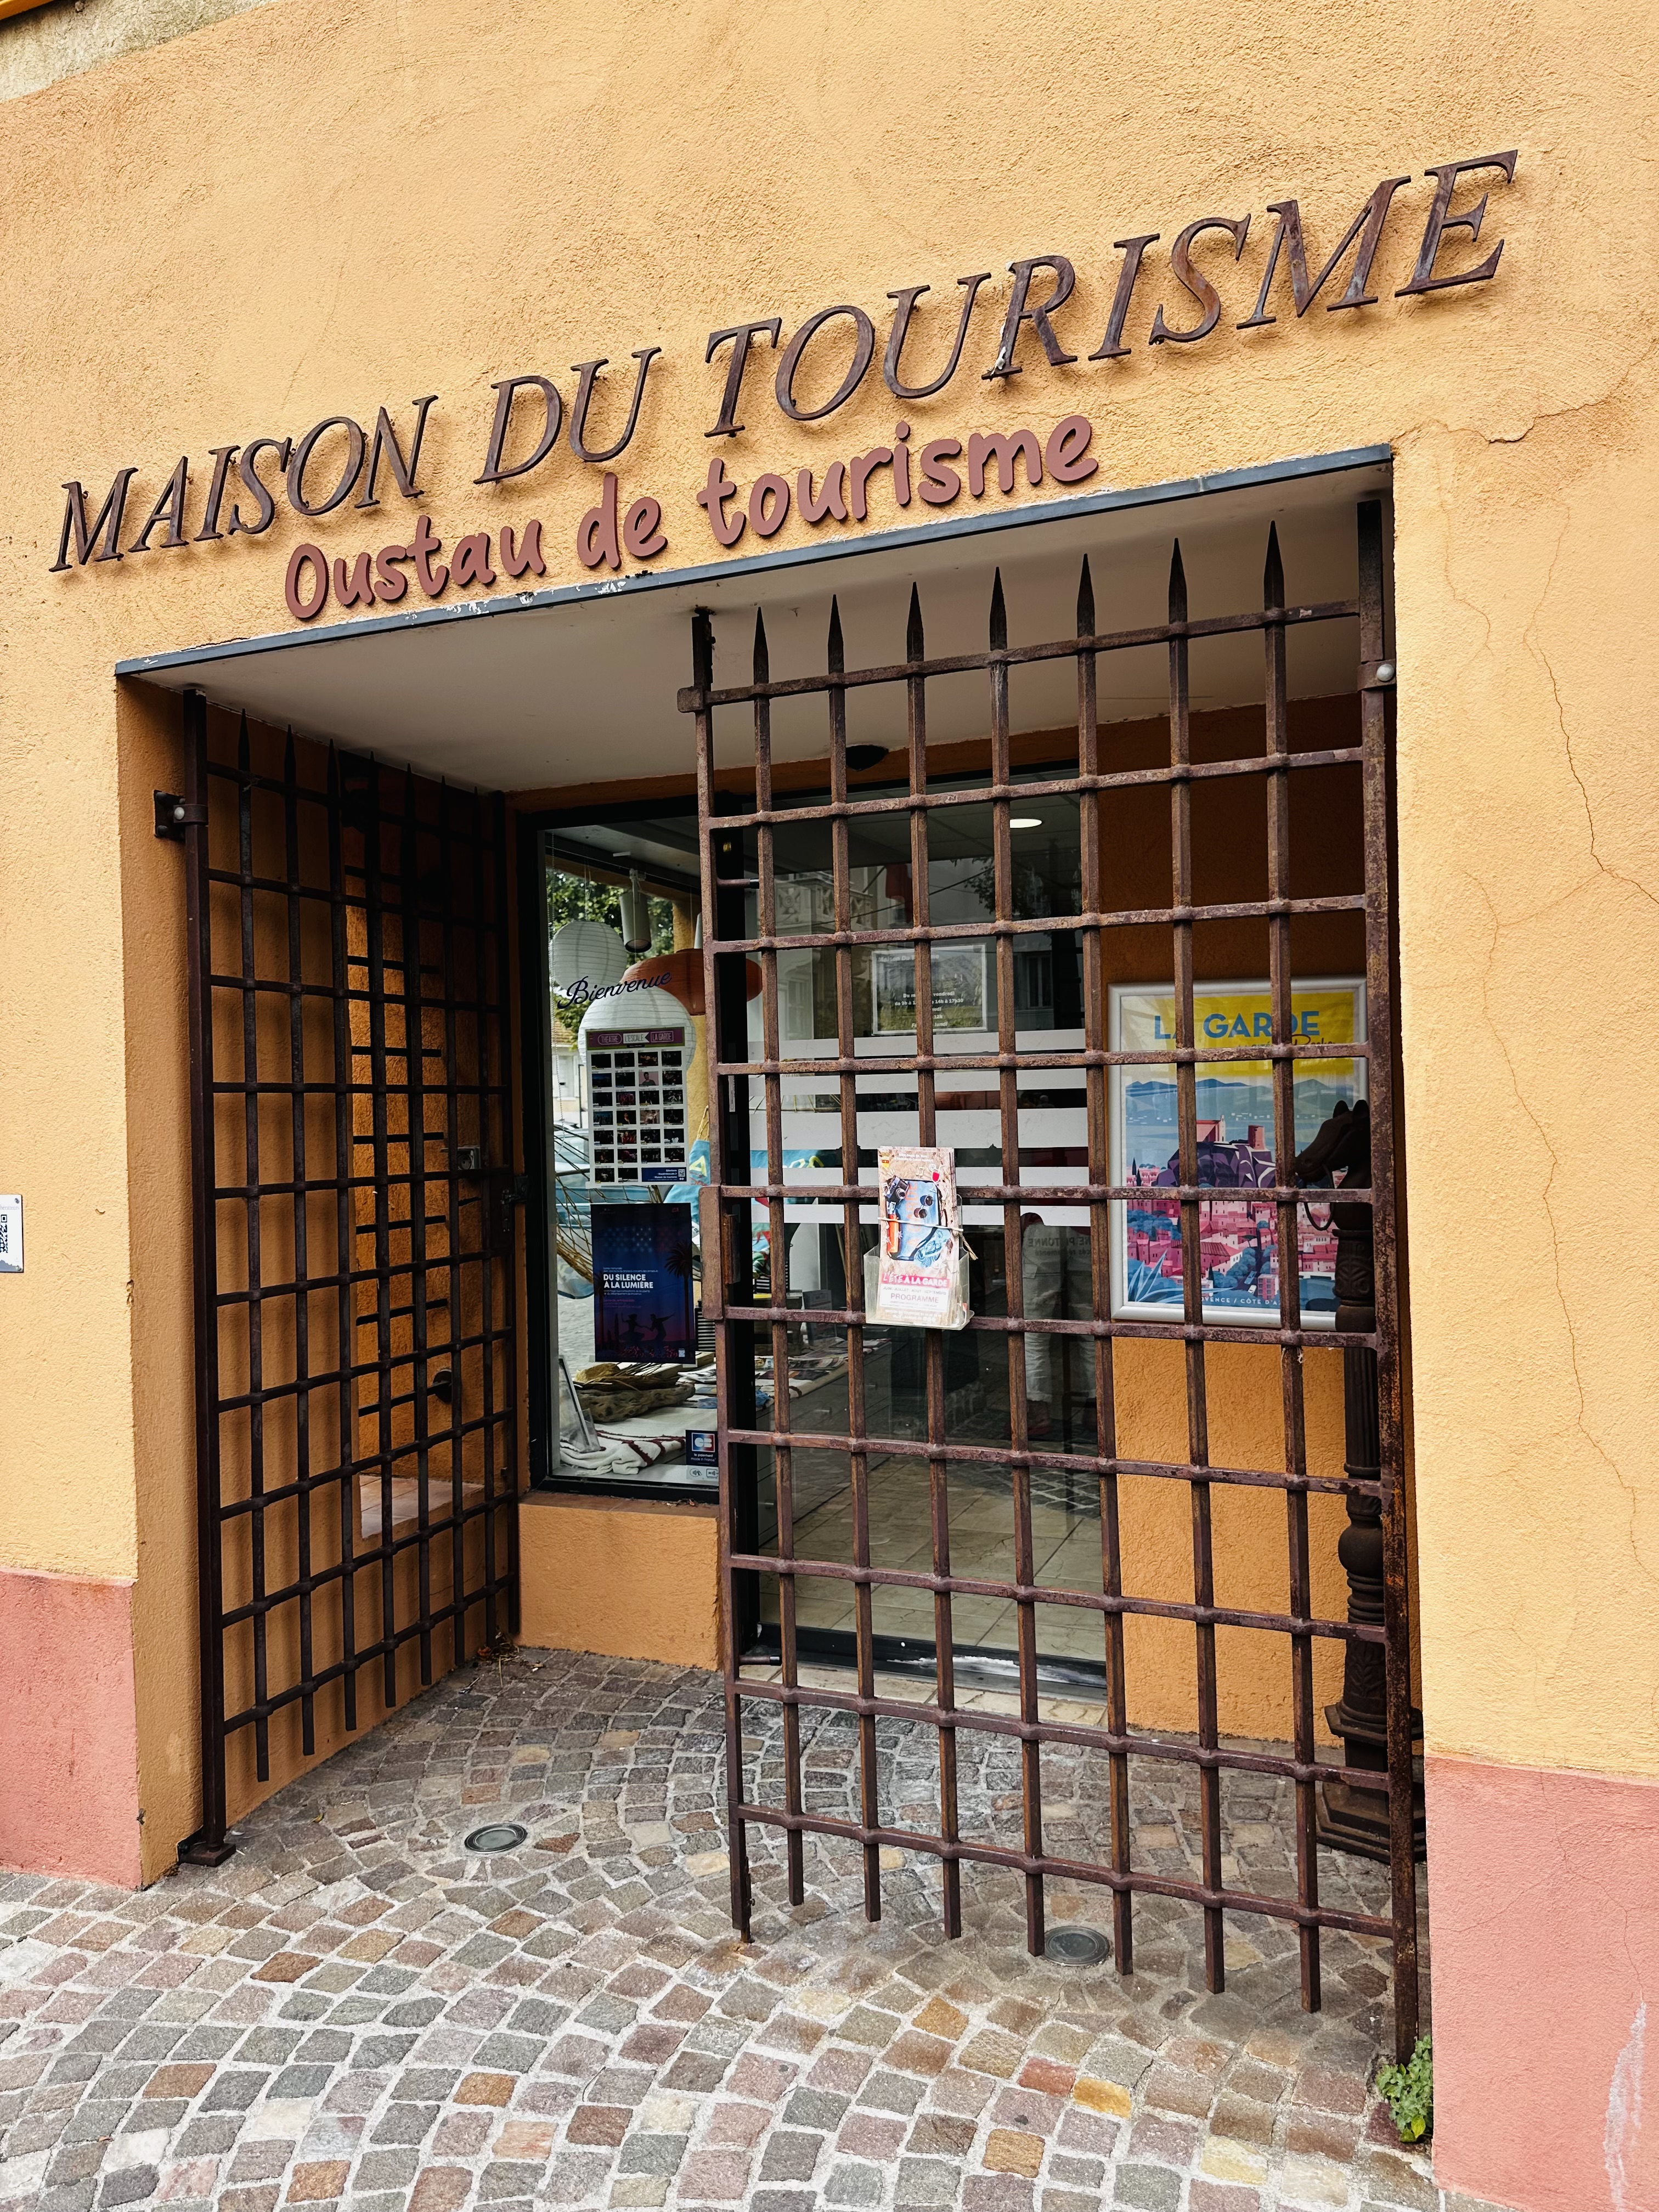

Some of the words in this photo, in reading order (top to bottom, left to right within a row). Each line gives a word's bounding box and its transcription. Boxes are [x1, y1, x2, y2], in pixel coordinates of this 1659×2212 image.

[48, 394, 439, 572] MAISON
[473, 347, 662, 484] DU
[704, 149, 1519, 438] TOURISME
[285, 515, 547, 619] Oustau
[577, 472, 668, 569] de
[697, 415, 1099, 546] tourisme
[557, 971, 673, 1009] Bienvenue
[1154, 1015, 1176, 1040] L
[911, 1276, 921, 1285] LA
[922, 1278, 947, 1286] GARDE
[890, 1293, 940, 1304] PROGRAMME
